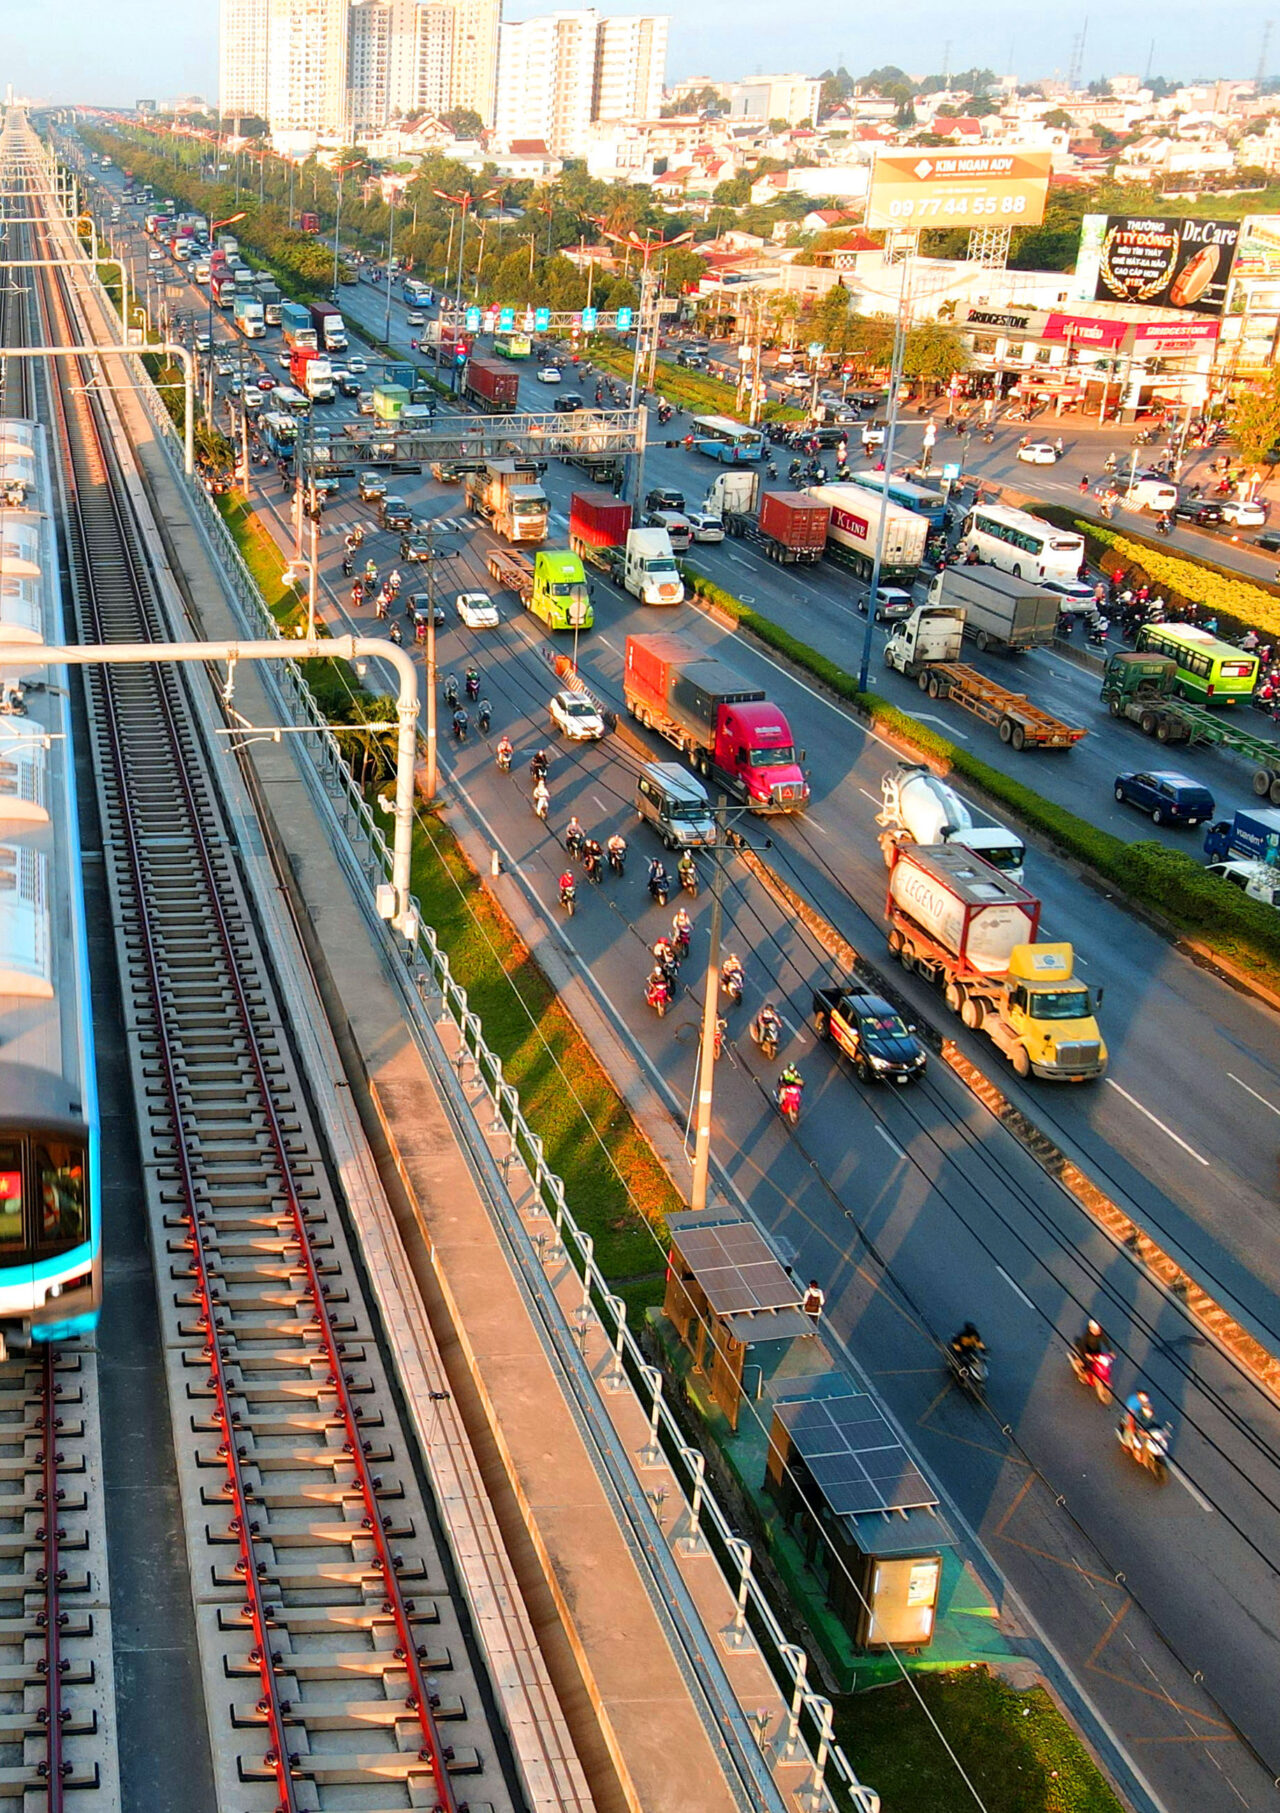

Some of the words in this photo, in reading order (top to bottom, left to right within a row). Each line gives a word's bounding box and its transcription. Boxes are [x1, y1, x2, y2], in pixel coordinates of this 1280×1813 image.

[936, 160, 956, 171] KIM
[990, 158, 1013, 170] ADV
[890, 200, 913, 216] 09
[919, 199, 941, 216] 77
[944, 198, 968, 214] 44
[973, 197, 997, 214] 55
[1002, 196, 1026, 213] 88
[1182, 221, 1237, 245] Dr.Care
[967, 309, 1029, 328] BRIDGESTONE
[1146, 326, 1210, 336] BRIDGESTONE
[846, 519, 867, 537] LINE
